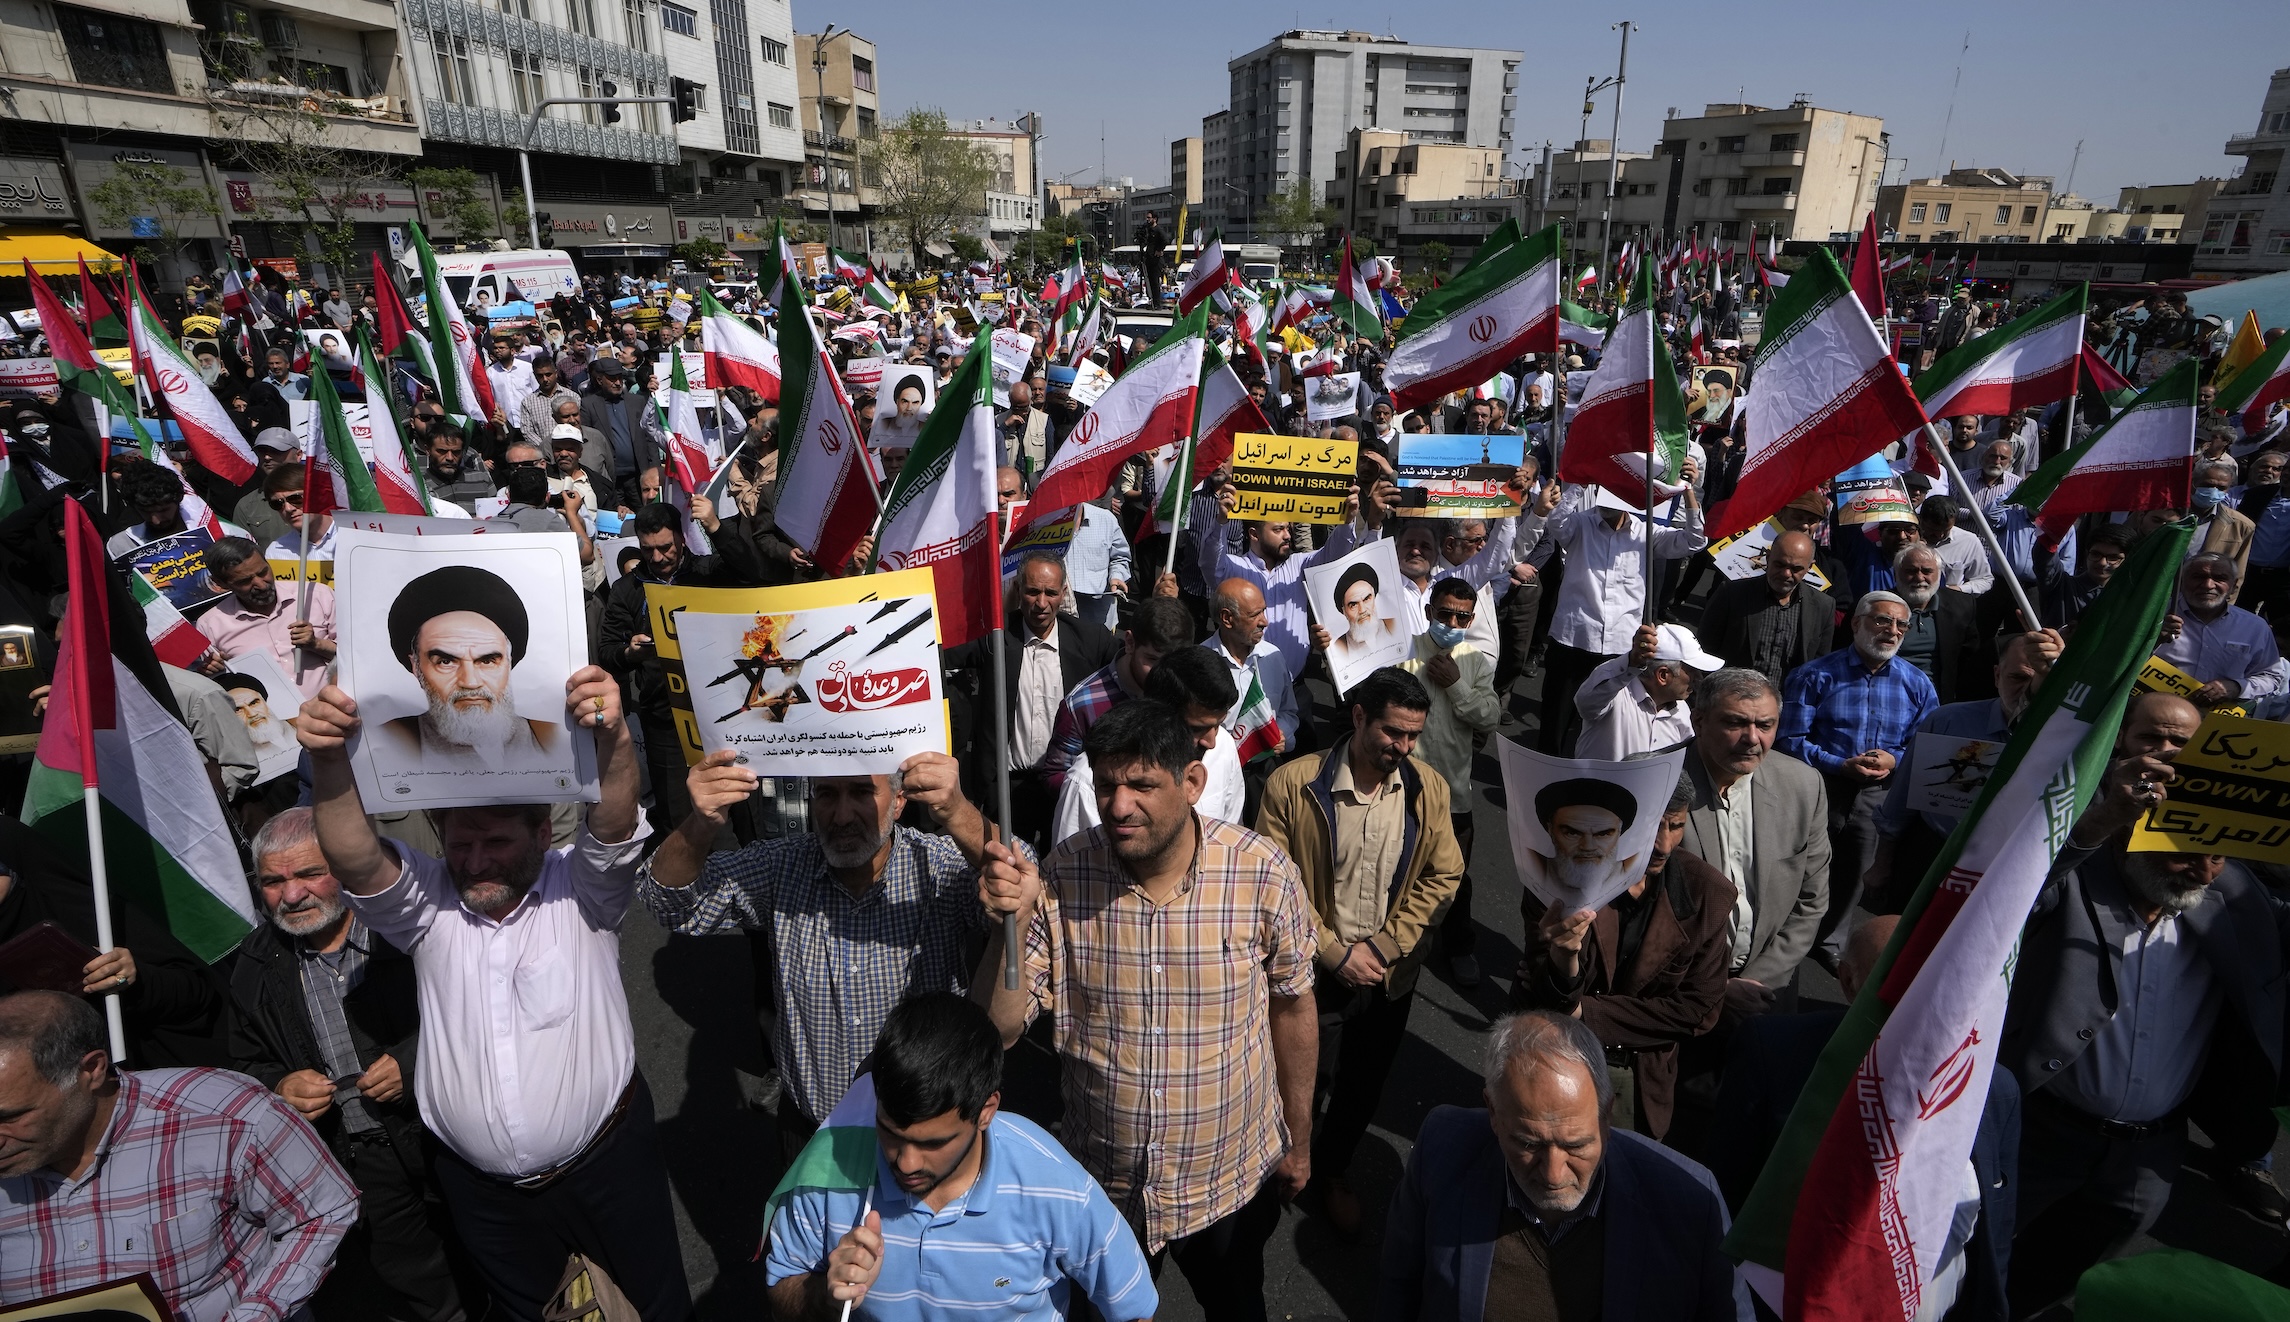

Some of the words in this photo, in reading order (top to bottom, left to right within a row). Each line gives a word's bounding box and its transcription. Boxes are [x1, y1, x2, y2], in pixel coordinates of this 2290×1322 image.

[553, 220, 574, 230] Bank
[576, 220, 598, 232] Sepah
[528, 278, 538, 286] 115
[27, 361, 51, 371] مرگ
[1238, 442, 1292, 464] اسرائیل
[1316, 446, 1351, 468] مرگ
[1296, 452, 1310, 467] بر
[1400, 466, 1415, 475] شد.
[1417, 467, 1449, 479] خواهد
[1451, 467, 1469, 478] آزاد
[1232, 473, 1270, 486] DOWN
[1274, 476, 1304, 488] WITH
[1307, 478, 1350, 490] ISRAEL
[1838, 482, 1852, 490] شد.
[1854, 479, 1882, 489] خواهد
[1419, 478, 1498, 502] فلسطی
[1462, 500, 1470, 508] این
[1472, 500, 1494, 508] خداوند
[1496, 500, 1511, 508] تقدیر
[1300, 501, 1346, 519] الموت
[1038, 530, 1050, 543] بر
[1052, 528, 1072, 540] مرگ
[150, 558, 175, 574] بعدی
[857, 730, 865, 740] با
[864, 728, 908, 742] صهیونیستی
[908, 723, 926, 736] رژیم
[725, 733, 744, 745] کرد؛
[744, 734, 766, 743] اشتباه
[766, 733, 788, 744] ایران
[794, 732, 828, 745] کنسولگری
[828, 733, 837, 742] به
[836, 730, 856, 741] حمله
[762, 748, 778, 758] شد.
[780, 748, 806, 758] خواهد
[808, 748, 818, 758] هم
[820, 746, 838, 758] تنبیه
[842, 747, 858, 757] شود
[859, 746, 877, 756] تنبیه
[878, 744, 894, 754] باید
[2200, 730, 2290, 772] ریکا
[401, 770, 425, 778] شیطان
